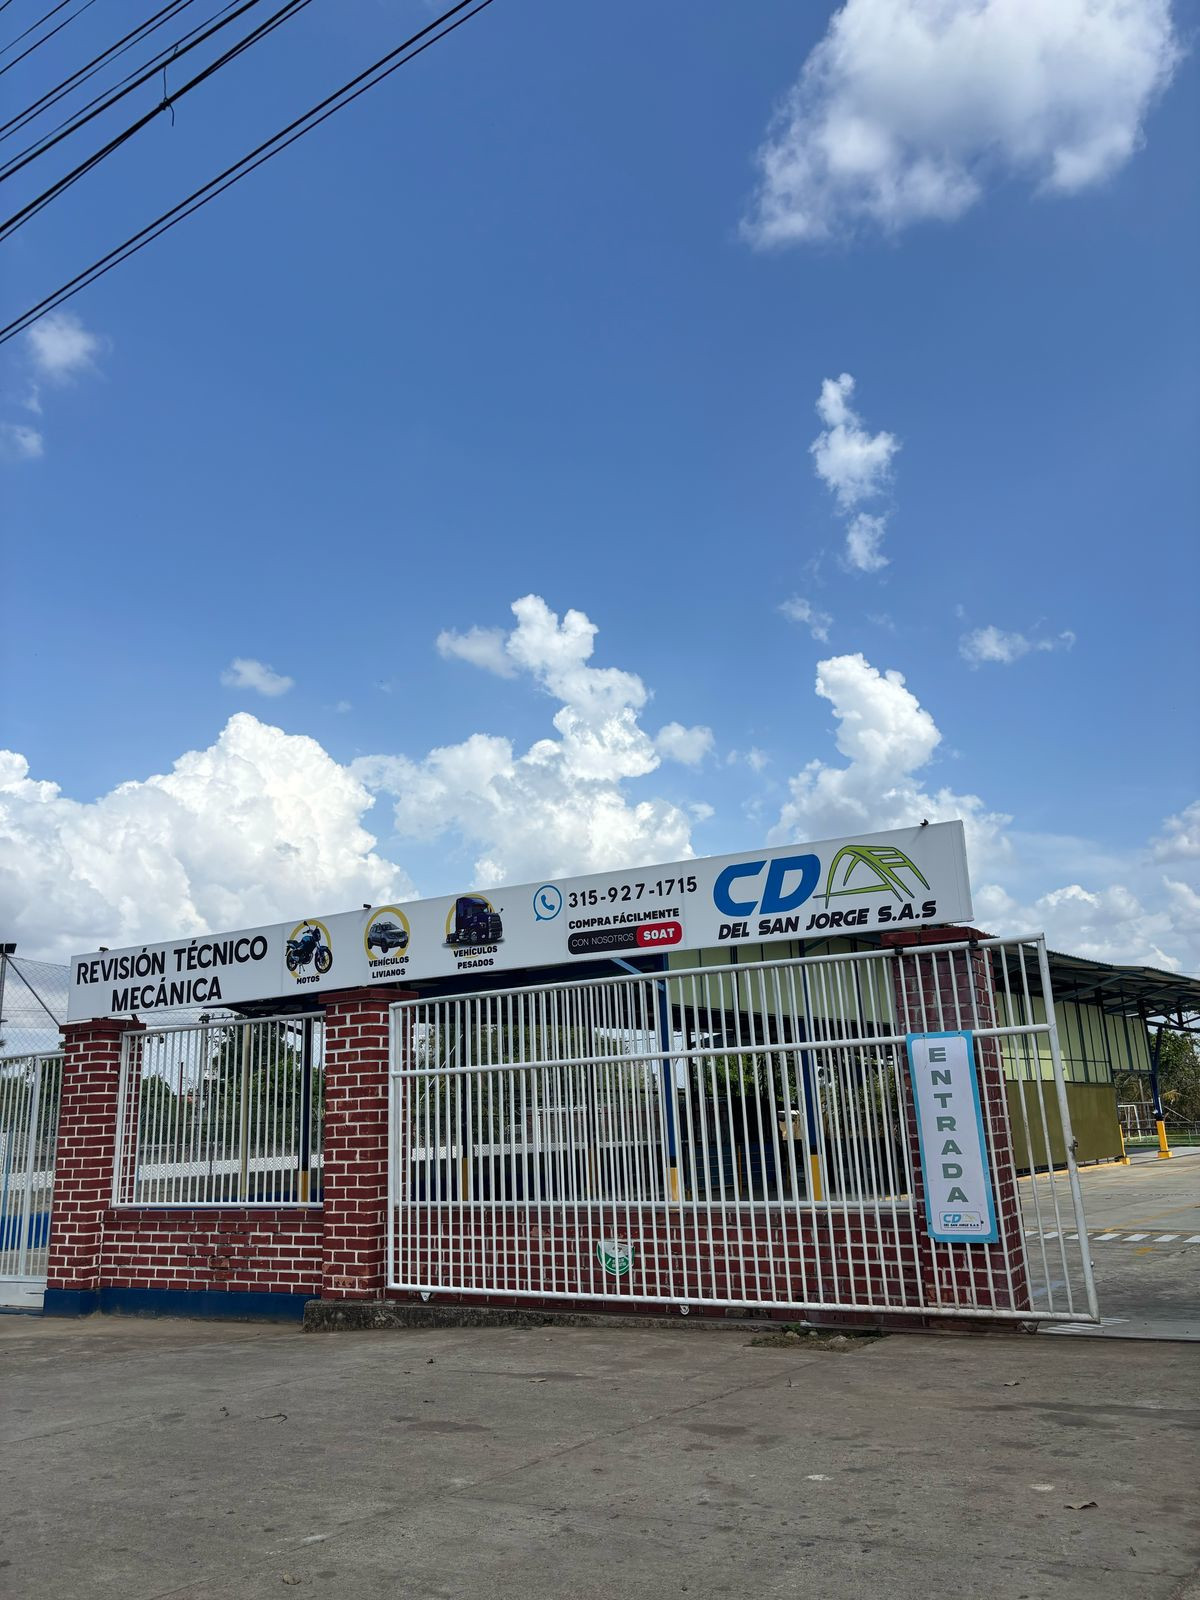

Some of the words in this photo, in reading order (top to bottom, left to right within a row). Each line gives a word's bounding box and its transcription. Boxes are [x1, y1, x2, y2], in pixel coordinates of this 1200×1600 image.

[568, 876, 697, 908] 315-927-1715
[568, 917, 611, 930] COMPRA
[613, 908, 679, 924] FÁCILMENTE
[718, 923, 749, 940] DEL
[758, 916, 799, 936] SAN
[806, 908, 870, 930] JORGE
[877, 901, 936, 923] S.A.S
[571, 938, 589, 948] CON
[591, 932, 634, 944] NOSOTROS
[643, 928, 675, 940] SOAT
[76, 948, 165, 985] REVISIÓN
[173, 935, 268, 972] TÉCNICO
[368, 956, 409, 967] VEHÍCULOS
[453, 945, 498, 958] VEHÍCULOS
[371, 968, 406, 978] LIVIANOS
[457, 958, 494, 969] PESADOS
[296, 975, 320, 984] MOTOS
[111, 976, 222, 1012] MECÁNICA
[928, 1047, 969, 1203] ENTRADA
